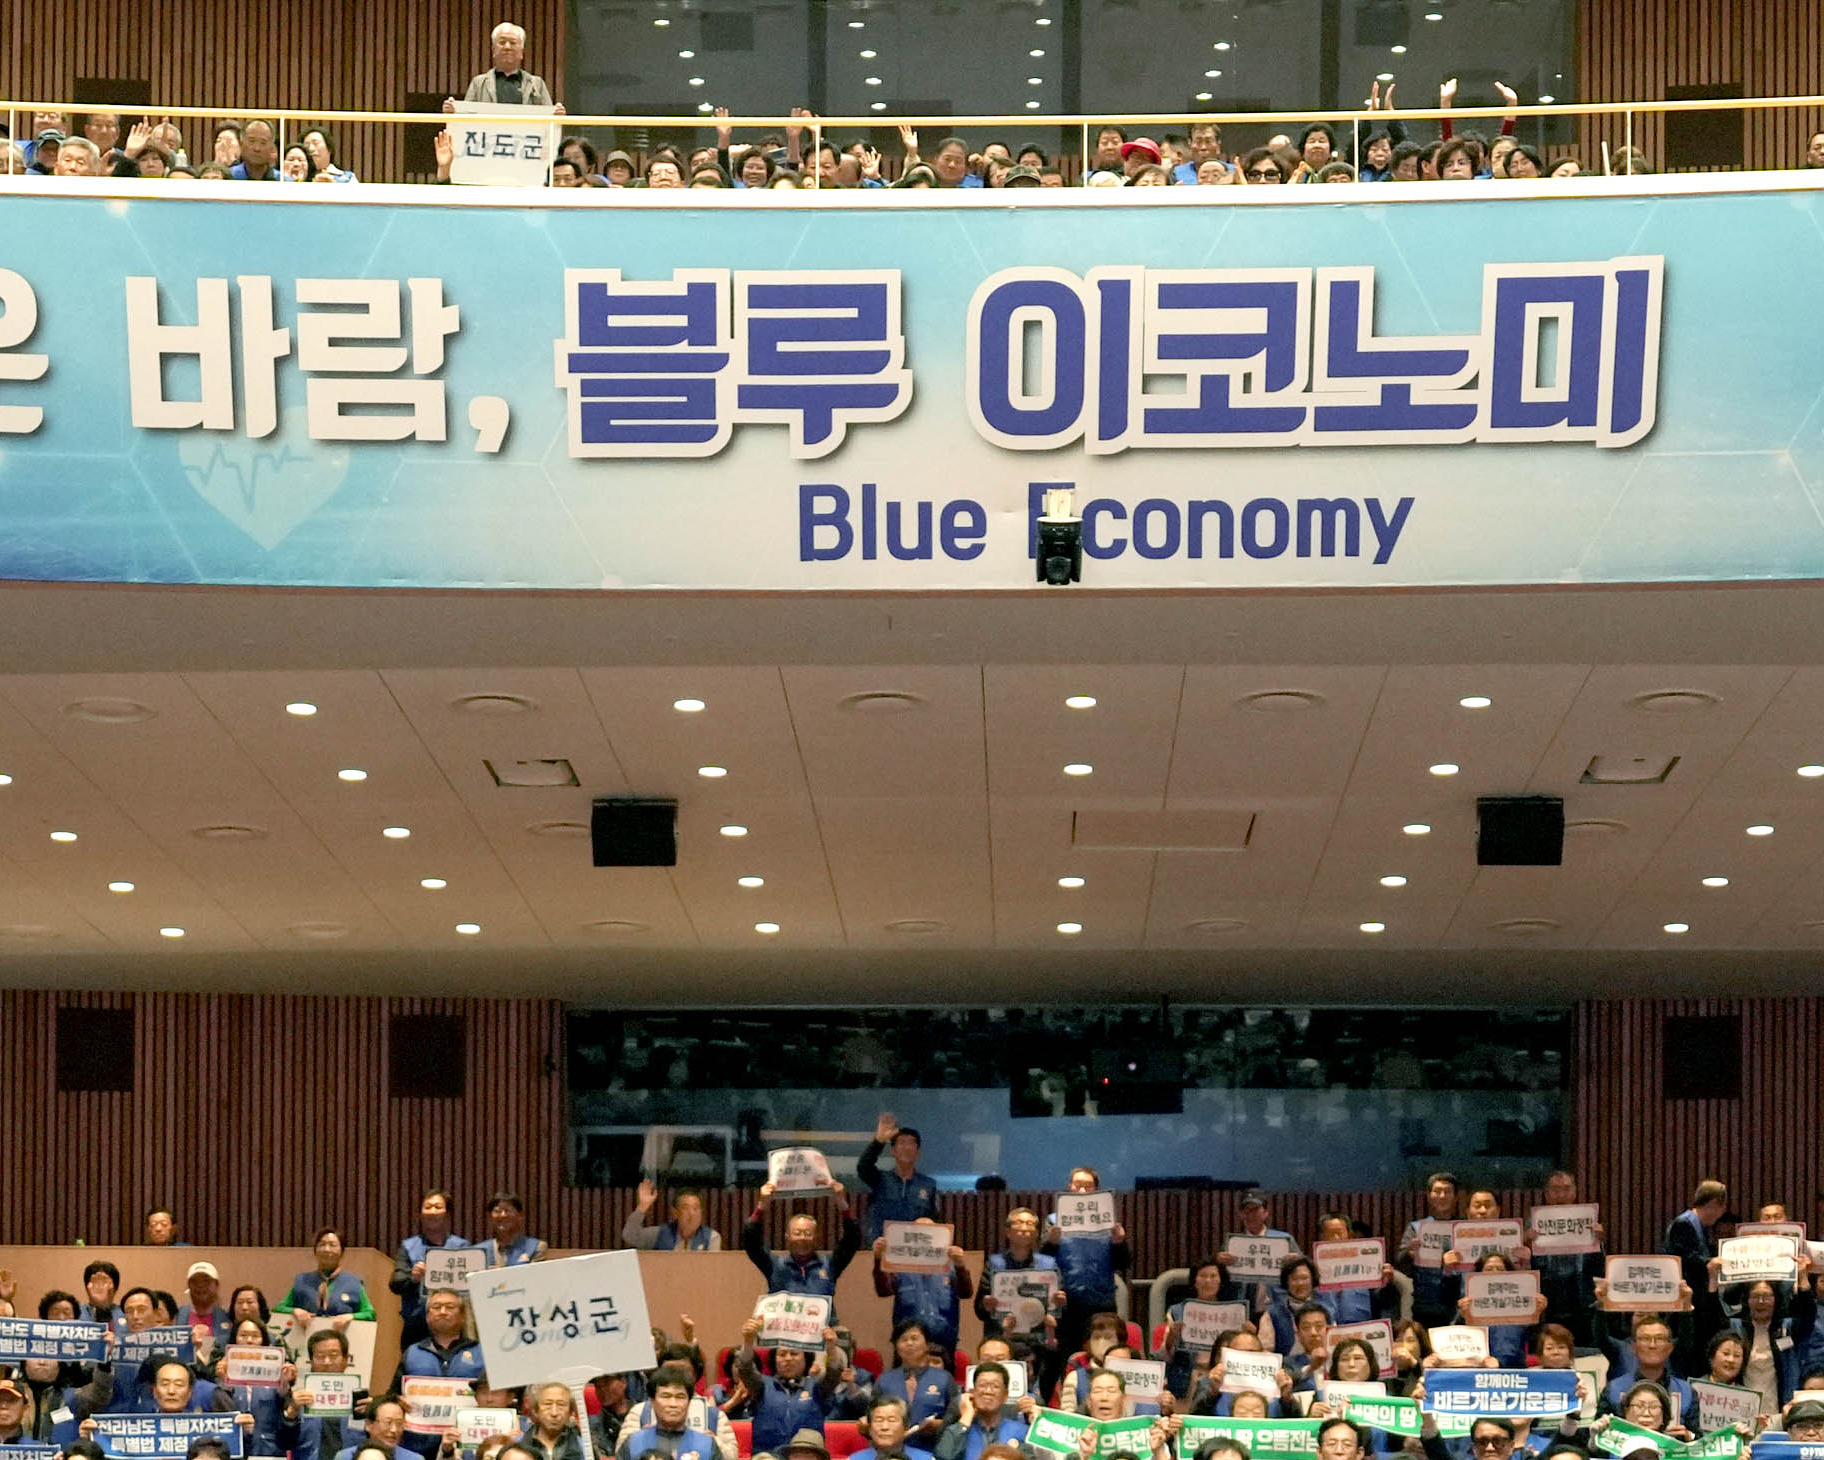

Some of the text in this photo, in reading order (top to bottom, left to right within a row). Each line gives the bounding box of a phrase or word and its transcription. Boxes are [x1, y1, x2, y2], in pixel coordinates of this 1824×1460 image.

[464, 131, 543, 159] 진도군
[126, 274, 511, 453] 바람,
[559, 261, 1660, 455] 블루 이코노미
[798, 484, 987, 562] Blue
[506, 1297, 619, 1345] 장성군
[1431, 1391, 1568, 1414] 바르게살기운동!
[1475, 1373, 1528, 1389] 함께하는
